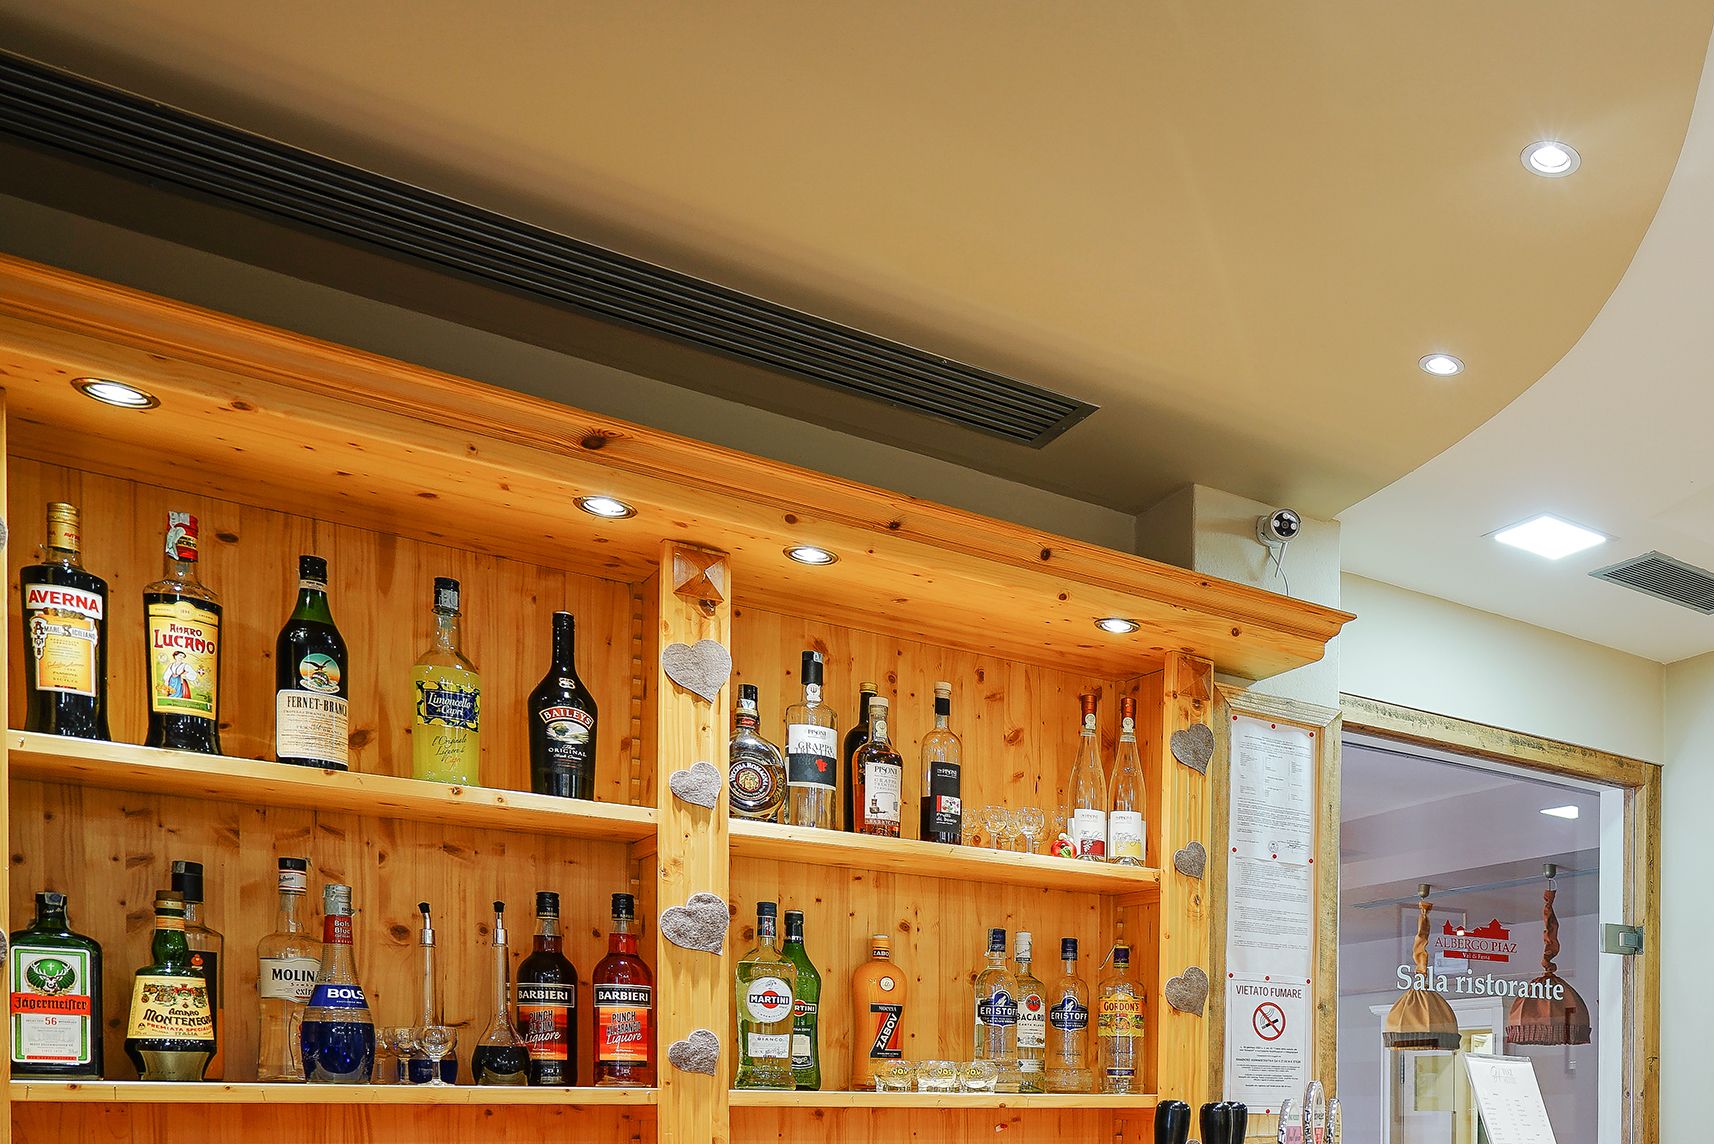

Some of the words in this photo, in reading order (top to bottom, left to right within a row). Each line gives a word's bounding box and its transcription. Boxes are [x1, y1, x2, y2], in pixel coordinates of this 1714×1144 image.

[28, 590, 99, 612] AVERNA
[169, 623, 203, 637] AMARO
[154, 629, 216, 655] LUCANO
[287, 696, 347, 716] FERNET-BRANC
[427, 692, 471, 709] Limoncello
[441, 704, 464, 716] Capri
[543, 708, 593, 725] BAILEYS
[548, 747, 587, 758] ORIGINAL
[874, 766, 898, 775] PISONI
[1435, 937, 1489, 952] ALBERGO
[1491, 942, 1518, 954] PIAZ
[1396, 964, 1449, 993] Sala
[1455, 968, 1565, 1001] ristorante
[327, 988, 365, 1000] BOLS
[518, 989, 569, 1001] BARBIERI
[598, 990, 649, 1002] BARBIERI
[1236, 985, 1269, 997] VIETATO
[1270, 987, 1302, 999] FUMARE
[750, 995, 789, 1005] MARTINI
[168, 1007, 200, 1017] AMARO
[794, 1004, 815, 1012] RTINI
[1103, 1001, 1140, 1012] GORDON'S
[45, 1017, 58, 1025] 56
[612, 1011, 636, 1023] PUNCH
[1050, 1012, 1088, 1021] ERISTOFF
[876, 1013, 898, 1050] ZABOV
[524, 1031, 561, 1048] Liquore
[606, 1032, 642, 1050] Liquore
